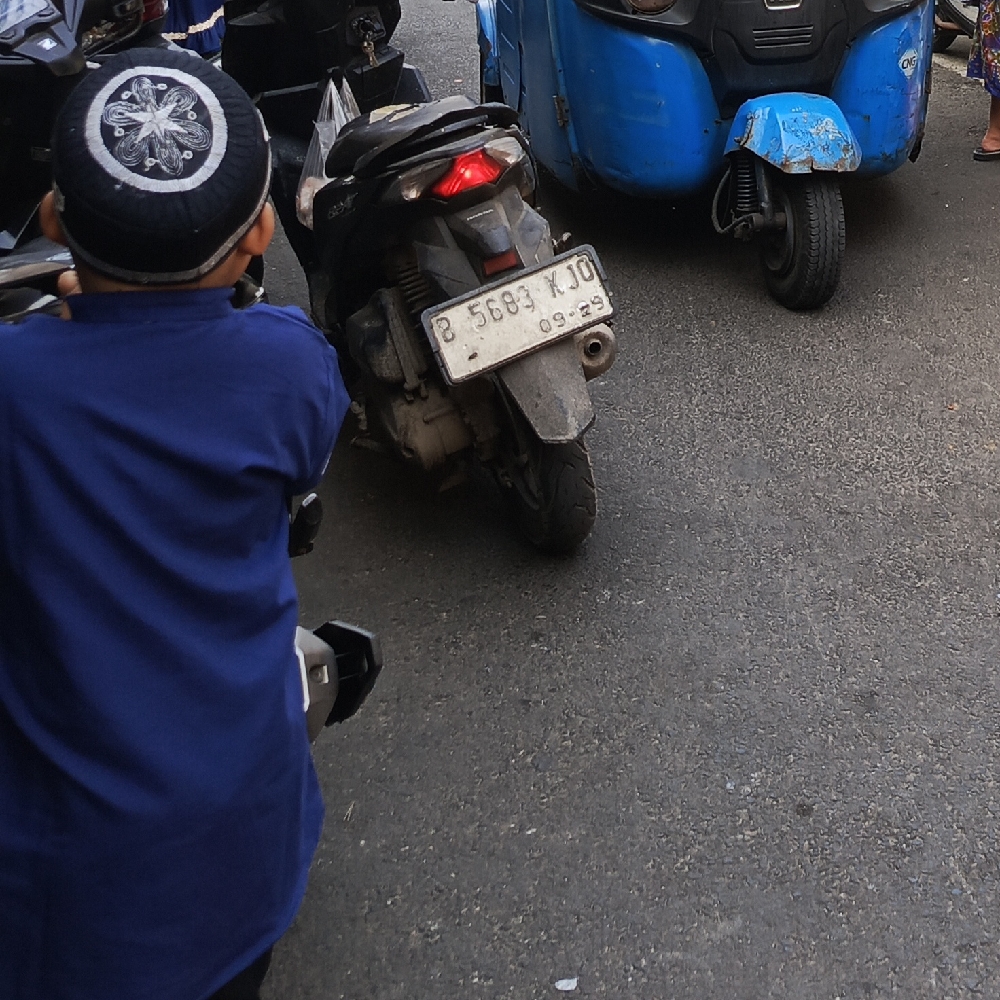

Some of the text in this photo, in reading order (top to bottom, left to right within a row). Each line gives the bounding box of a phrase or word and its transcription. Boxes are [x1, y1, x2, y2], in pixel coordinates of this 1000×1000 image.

[901, 55, 917, 70] CNG
[436, 316, 456, 343] B
[467, 284, 535, 328] 5683
